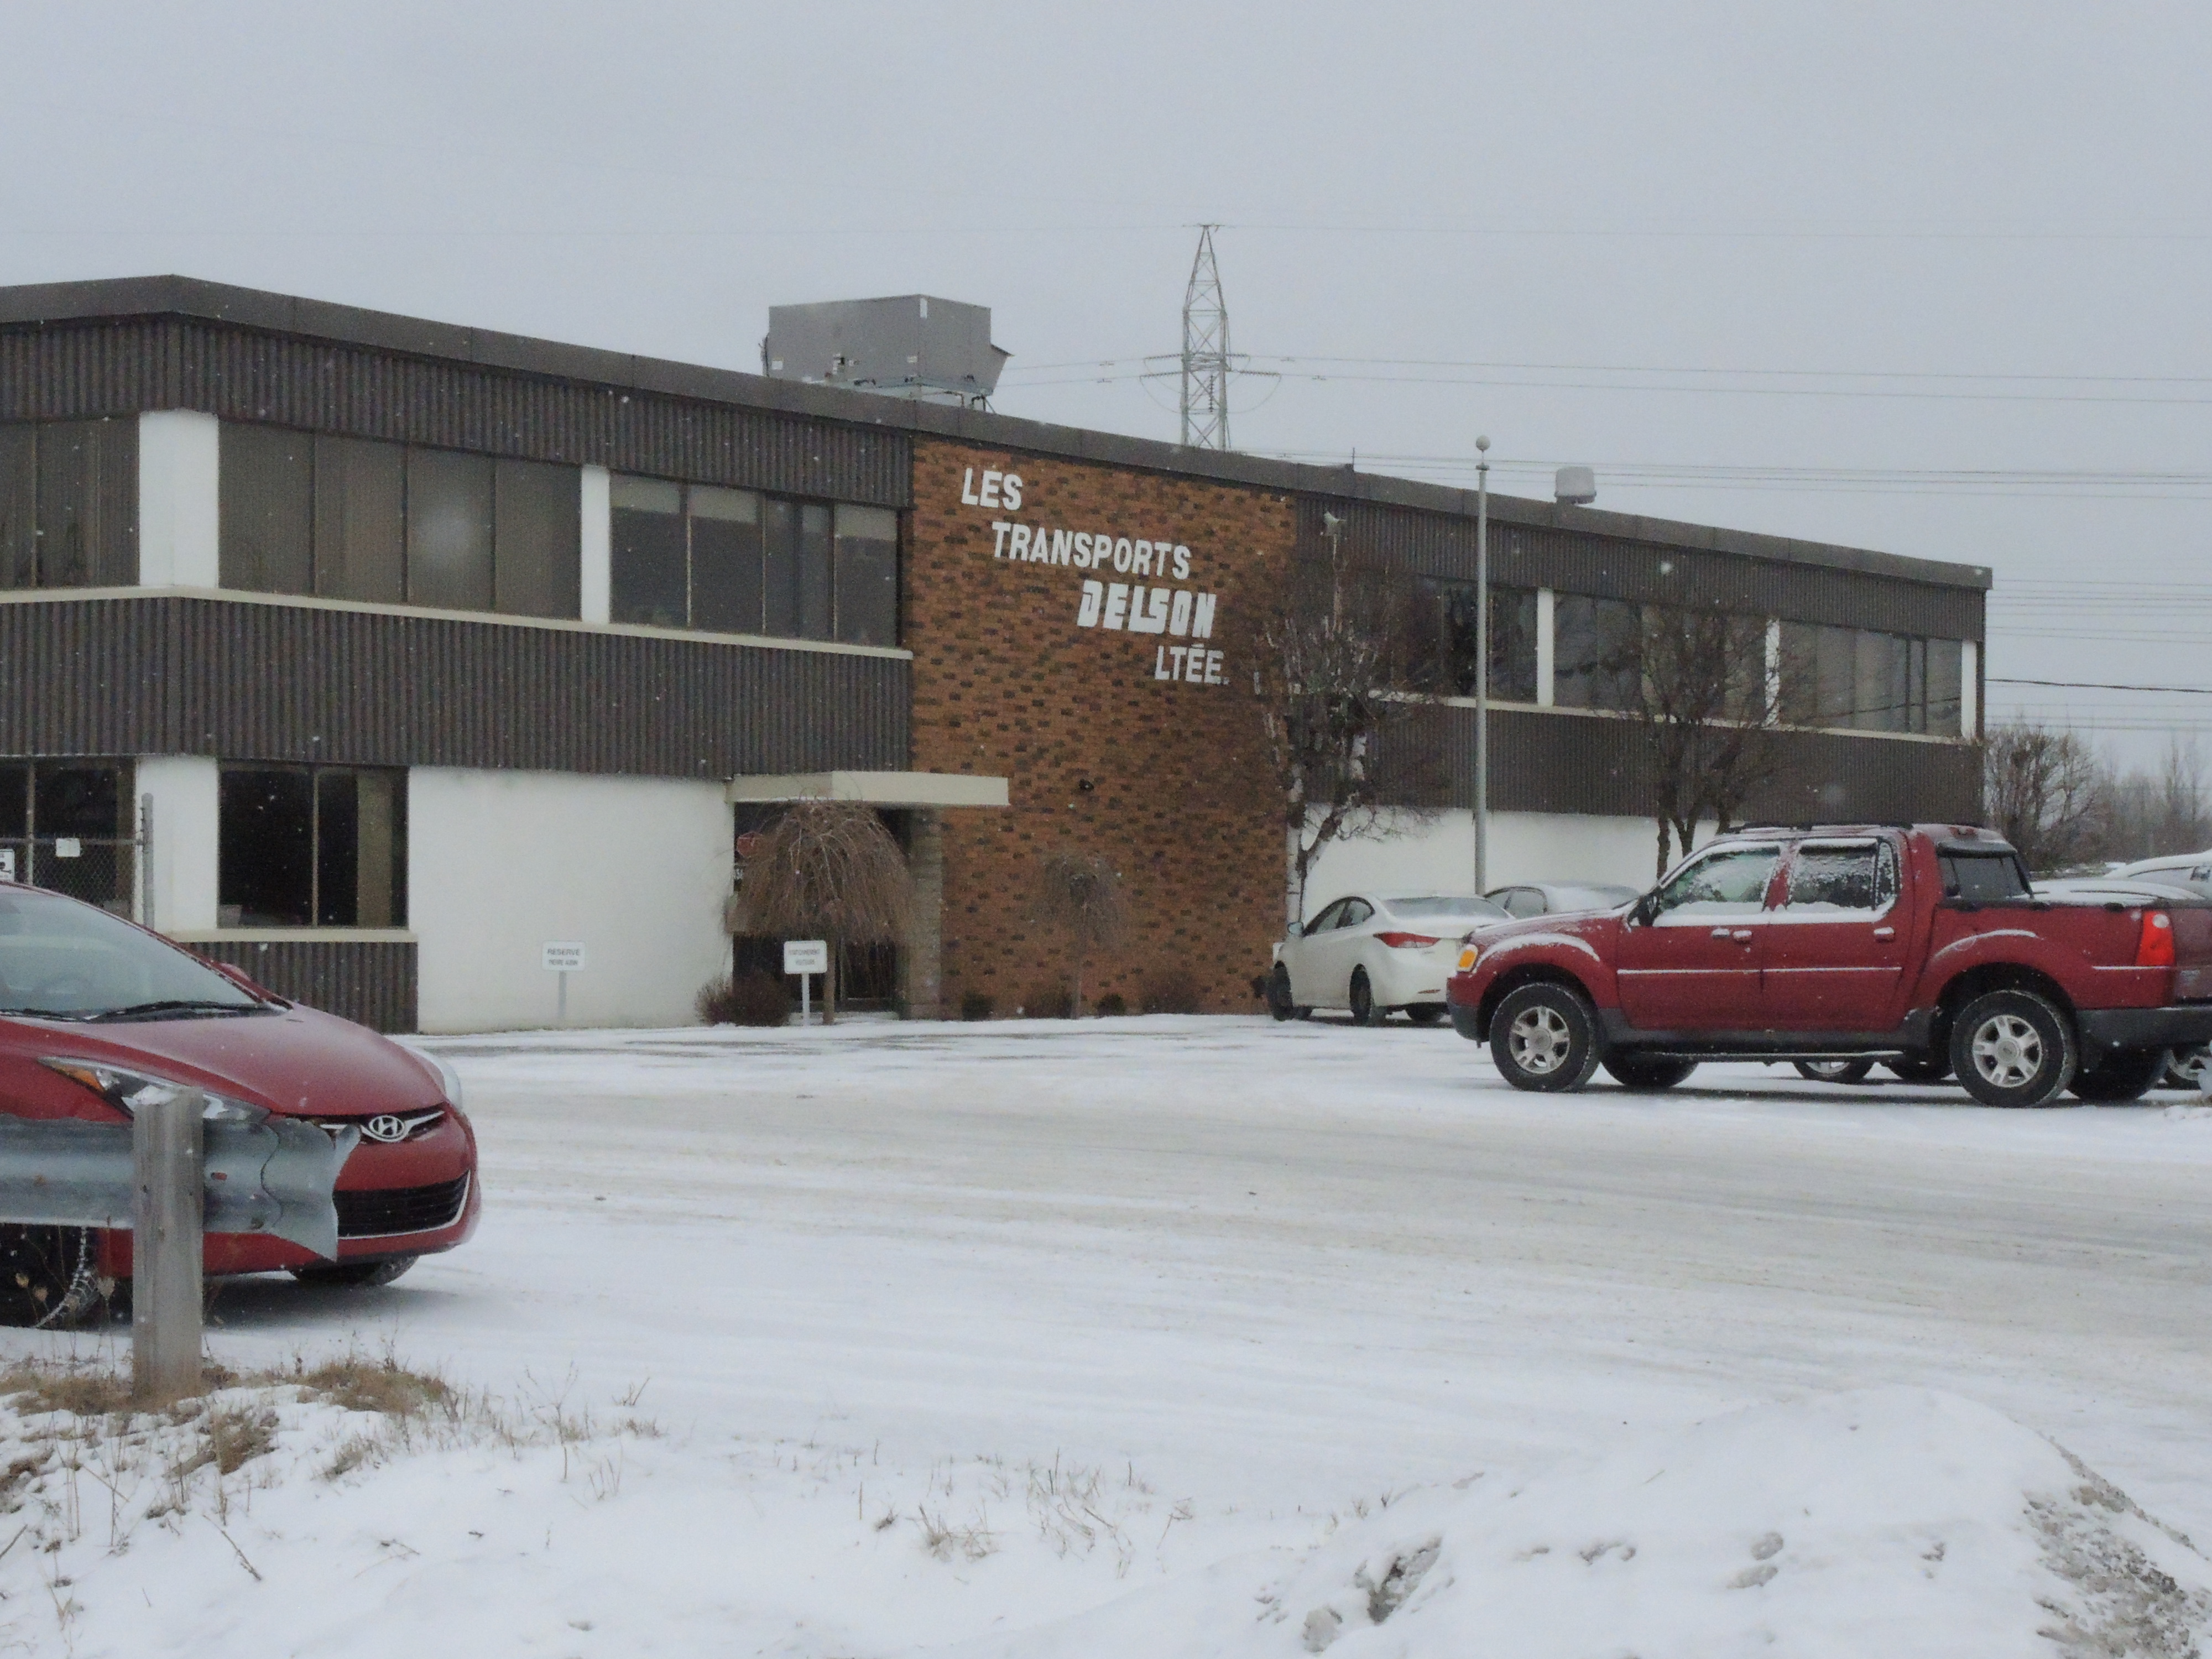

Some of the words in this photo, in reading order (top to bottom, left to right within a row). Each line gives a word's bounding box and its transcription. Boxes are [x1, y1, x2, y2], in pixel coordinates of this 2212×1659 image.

[962, 467, 1022, 510] LES
[992, 521, 1191, 580] TRANSPORTS
[1077, 580, 1217, 638] DELSON
